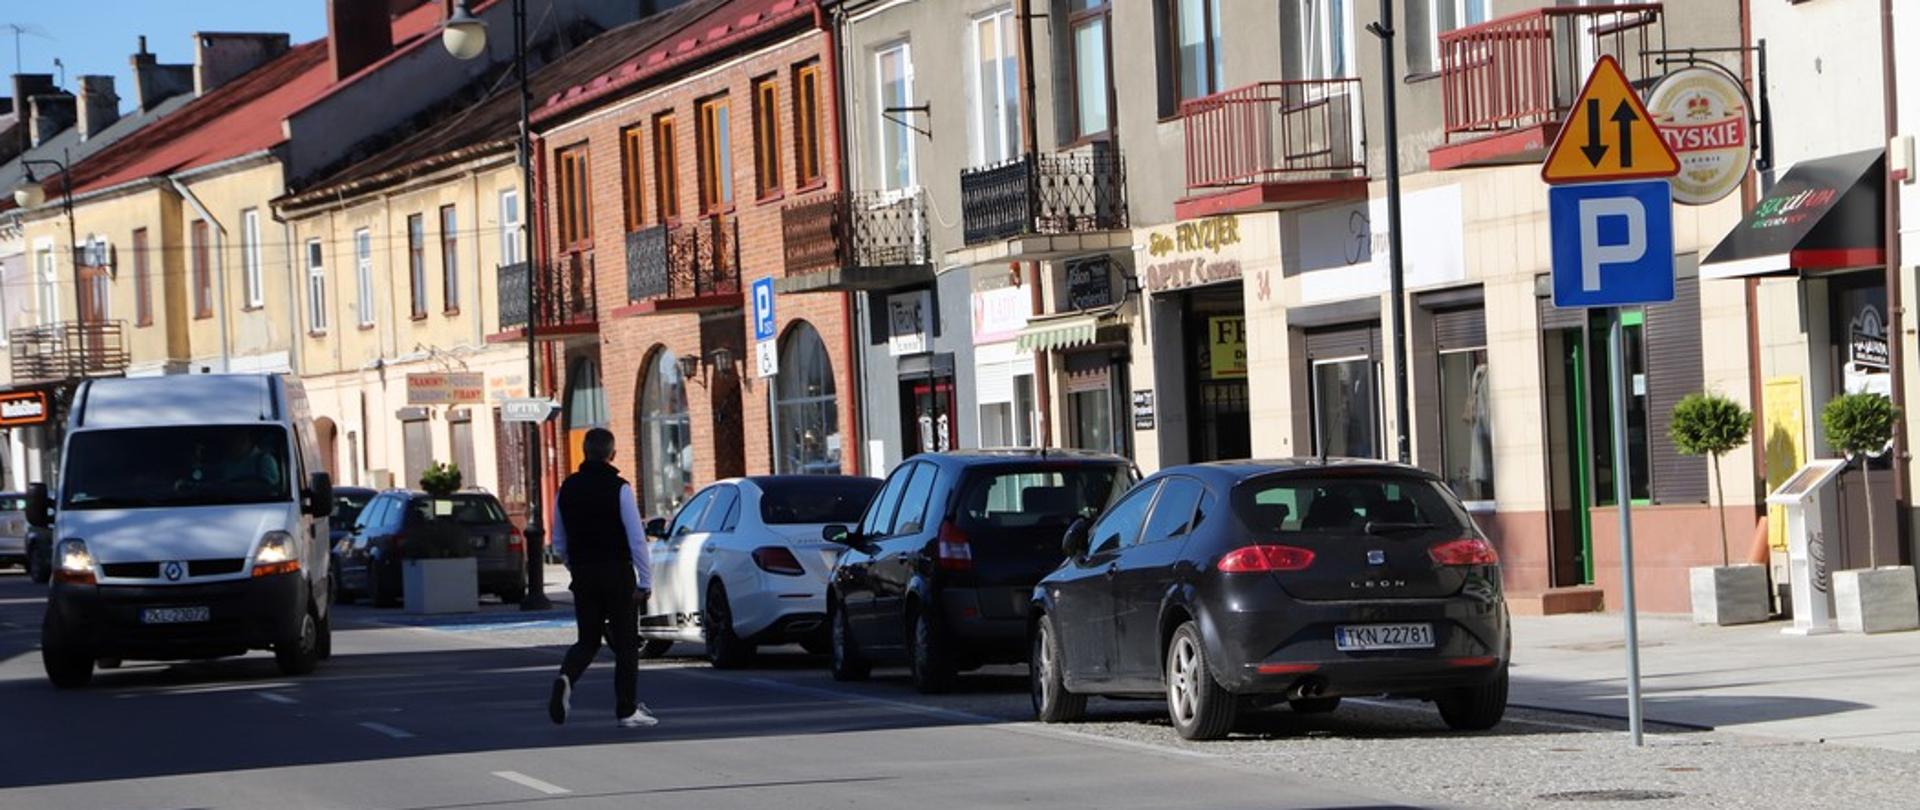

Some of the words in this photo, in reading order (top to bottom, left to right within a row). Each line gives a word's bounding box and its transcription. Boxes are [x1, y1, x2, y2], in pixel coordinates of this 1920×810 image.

[1660, 122, 1740, 149] TYSKIE
[1578, 195, 1647, 292] P
[1256, 269, 1271, 301] 34
[756, 284, 770, 333] P
[1350, 579, 1406, 588] LEON
[1345, 628, 1377, 645] TKN
[1382, 626, 1429, 644] 22781
